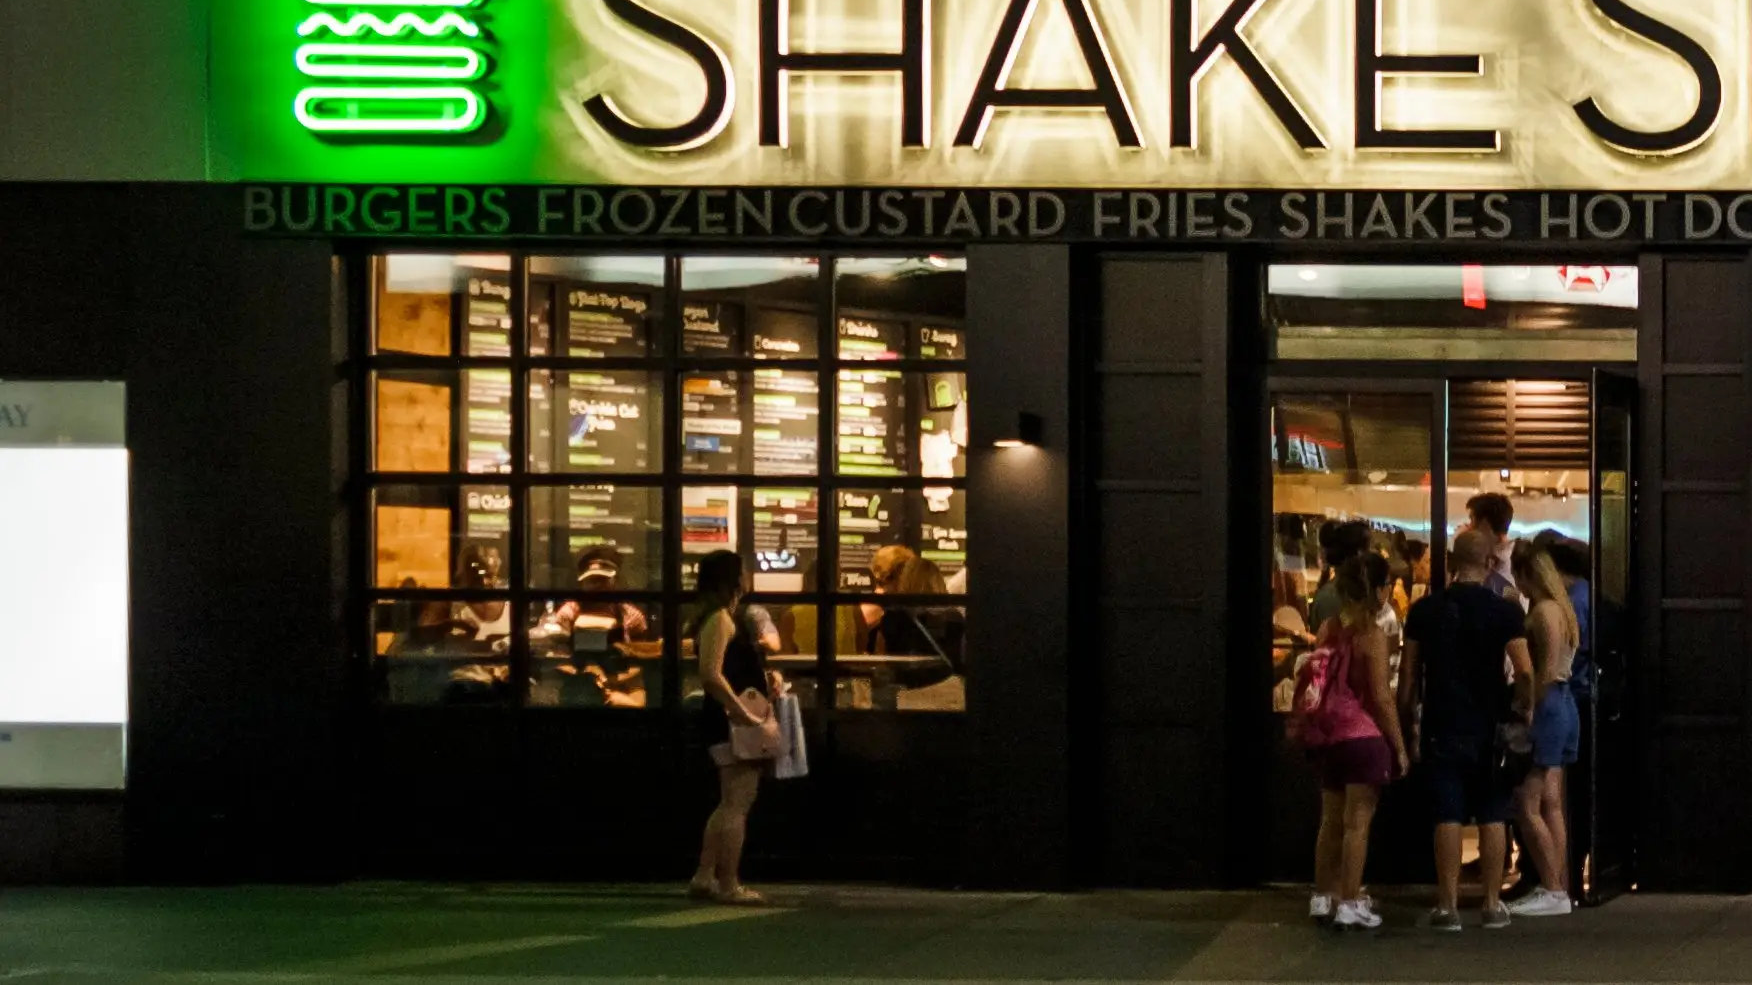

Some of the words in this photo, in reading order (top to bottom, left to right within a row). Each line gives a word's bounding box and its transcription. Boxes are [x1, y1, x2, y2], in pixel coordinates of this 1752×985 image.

[243, 186, 511, 234] BURGERS
[538, 188, 774, 236] FROZEN
[789, 190, 1066, 238] CUSTARD
[1092, 191, 1254, 239] FRIES
[1279, 192, 1513, 239] SHAKES
[1540, 193, 1668, 239] HOT
